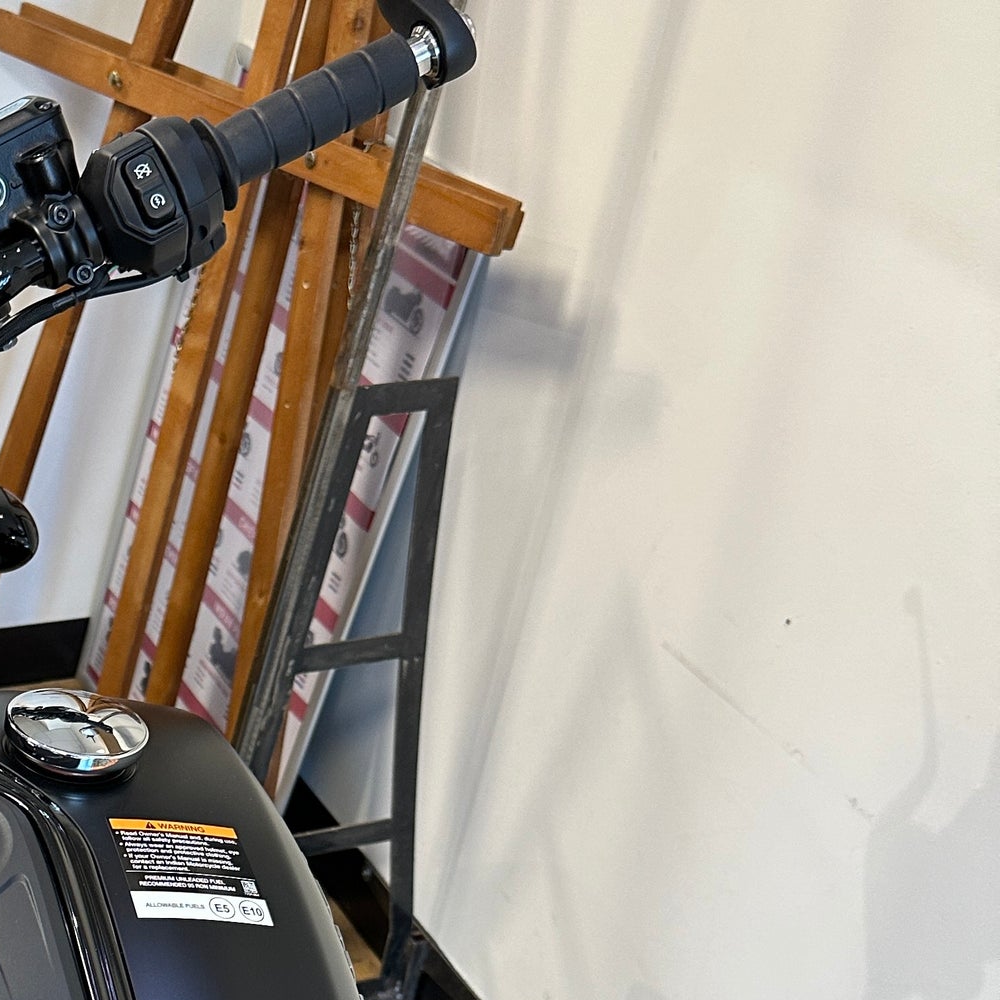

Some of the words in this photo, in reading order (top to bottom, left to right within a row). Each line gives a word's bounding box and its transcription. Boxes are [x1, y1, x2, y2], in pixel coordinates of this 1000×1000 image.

[158, 823, 205, 833] WARNING
[203, 836, 224, 844] during
[173, 849, 205, 857] protective
[186, 861, 221, 869] Motorcycle
[175, 876, 209, 884] UNLEADED
[138, 880, 187, 888] RECOMMENDED
[209, 884, 236, 892] MINIMUM
[214, 903, 230, 913] E5
[242, 906, 262, 917] E10
